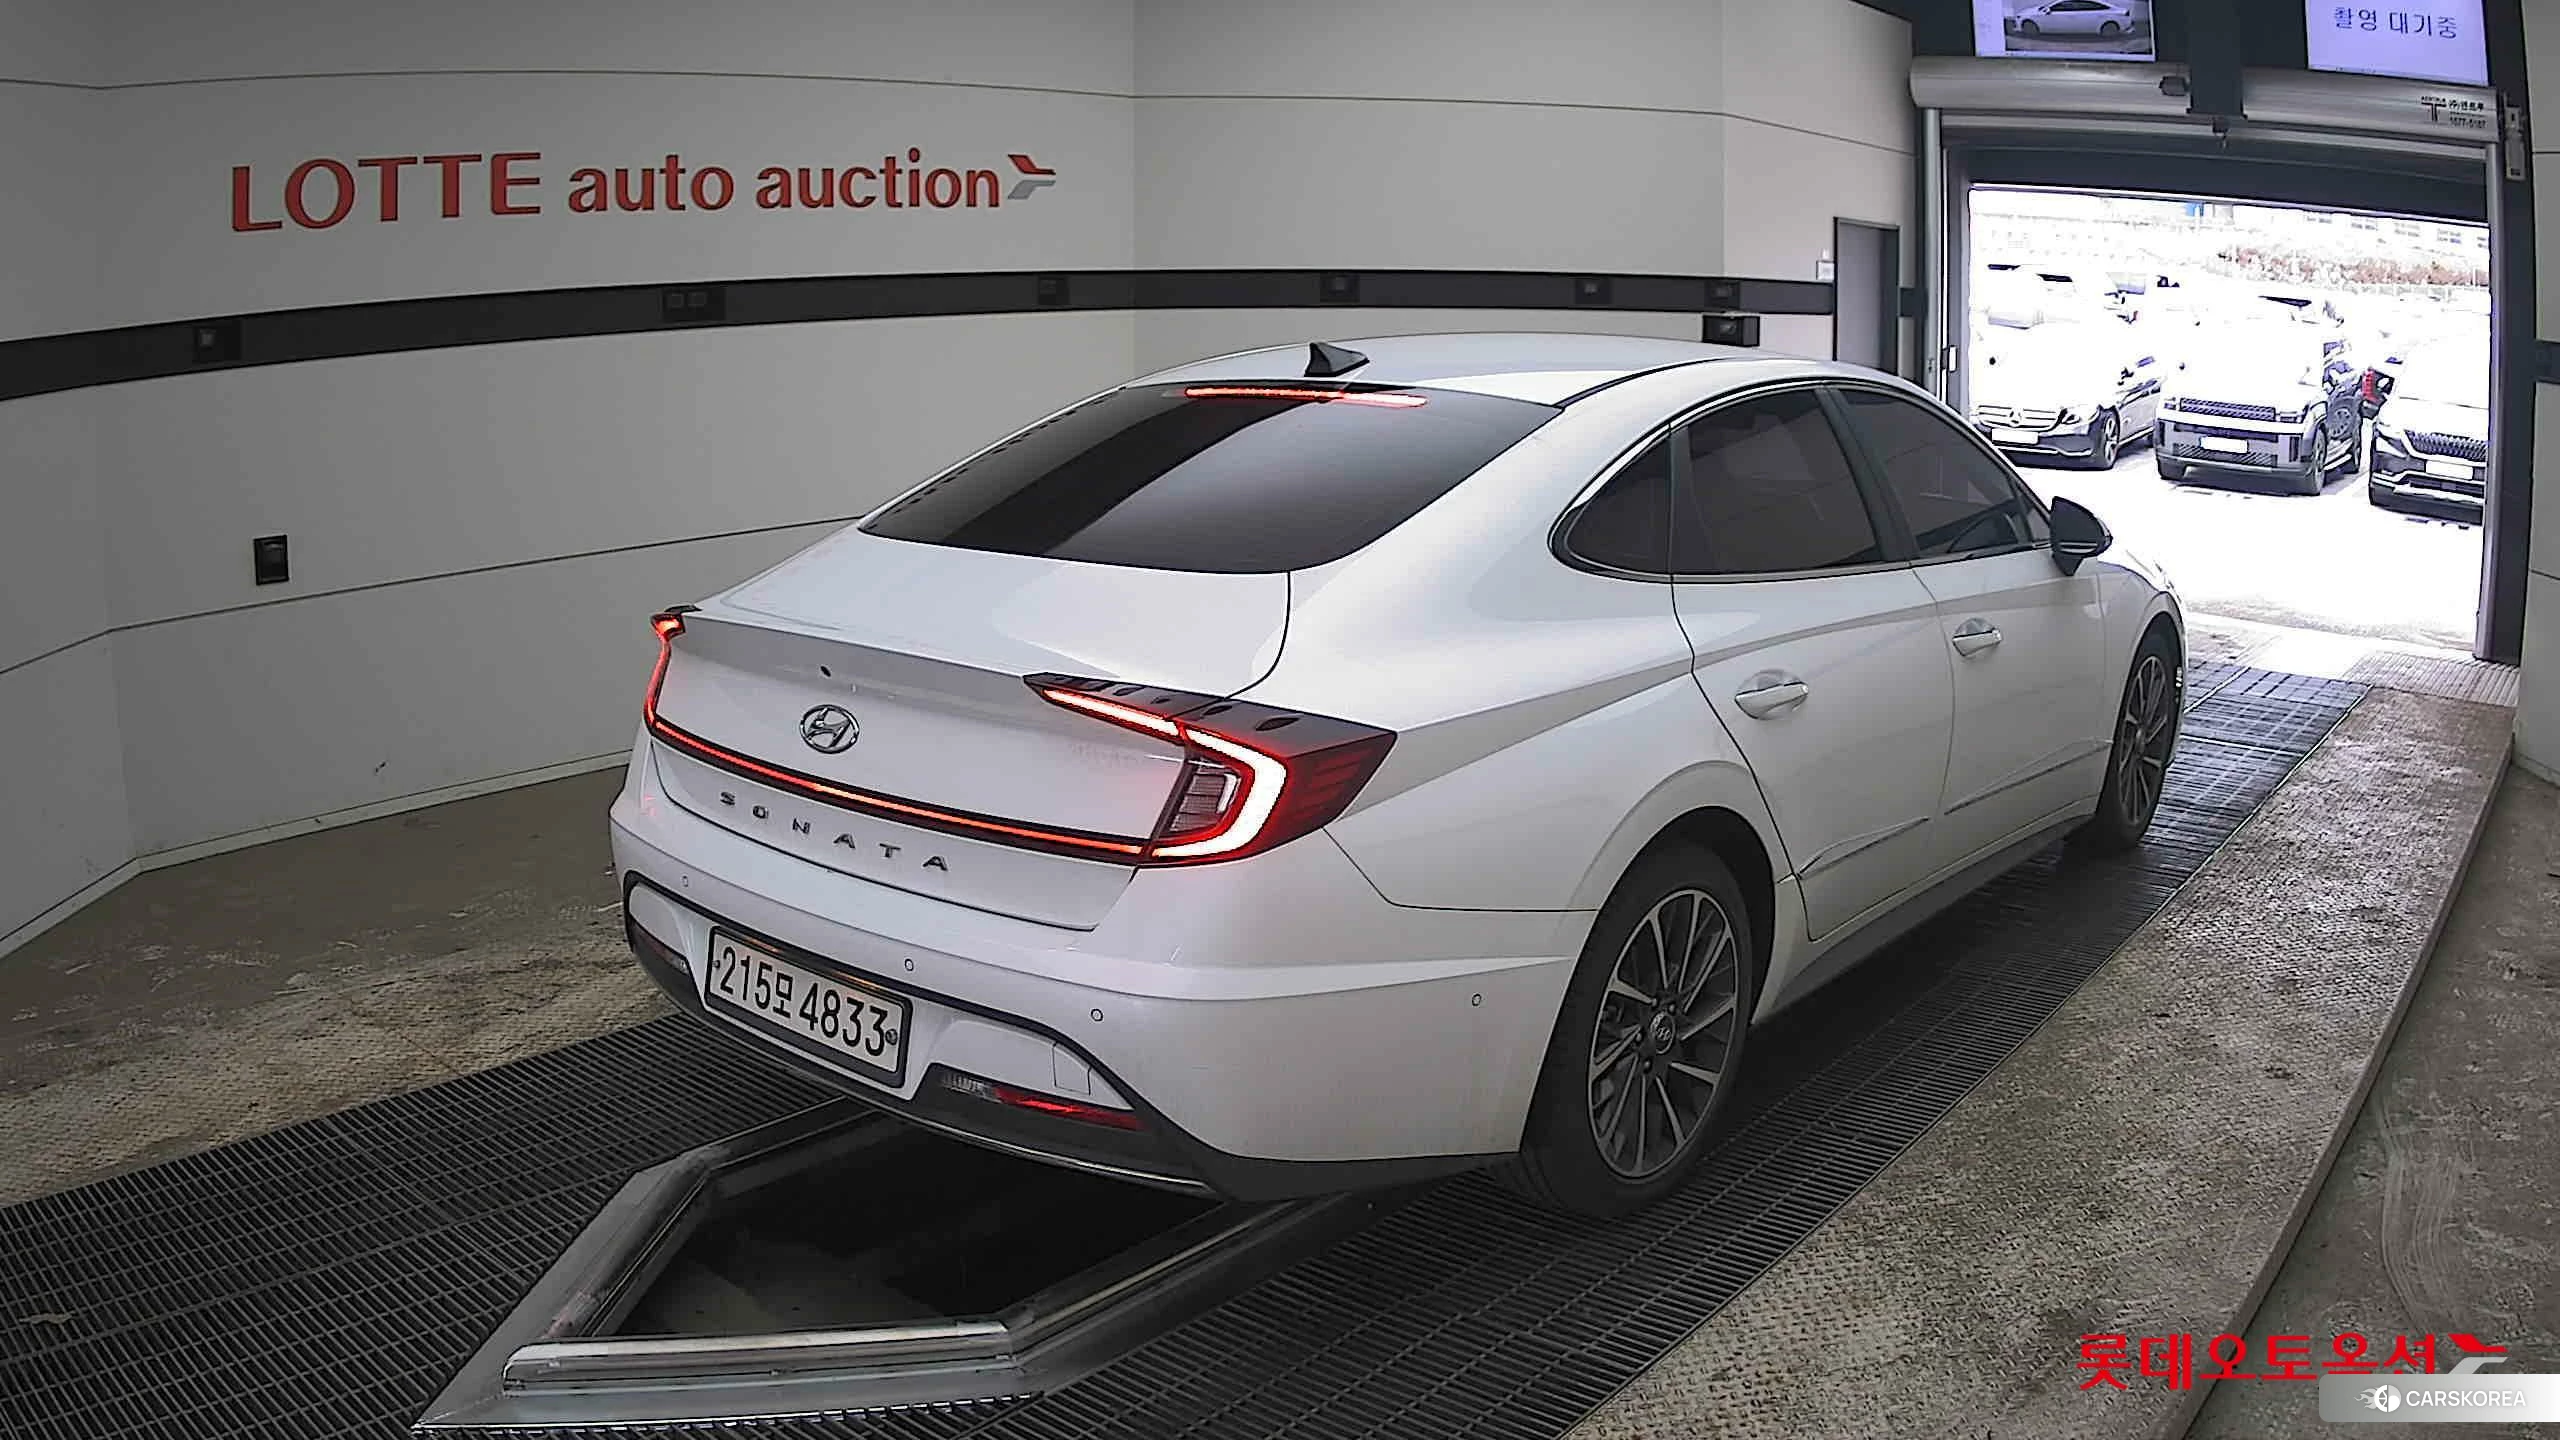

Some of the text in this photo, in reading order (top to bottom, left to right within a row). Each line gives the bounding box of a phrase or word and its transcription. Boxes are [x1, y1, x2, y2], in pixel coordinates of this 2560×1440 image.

[2389, 12, 2457, 39] 대기중
[232, 147, 1000, 232] LOTTE auto auction
[719, 791, 948, 872] SONATA
